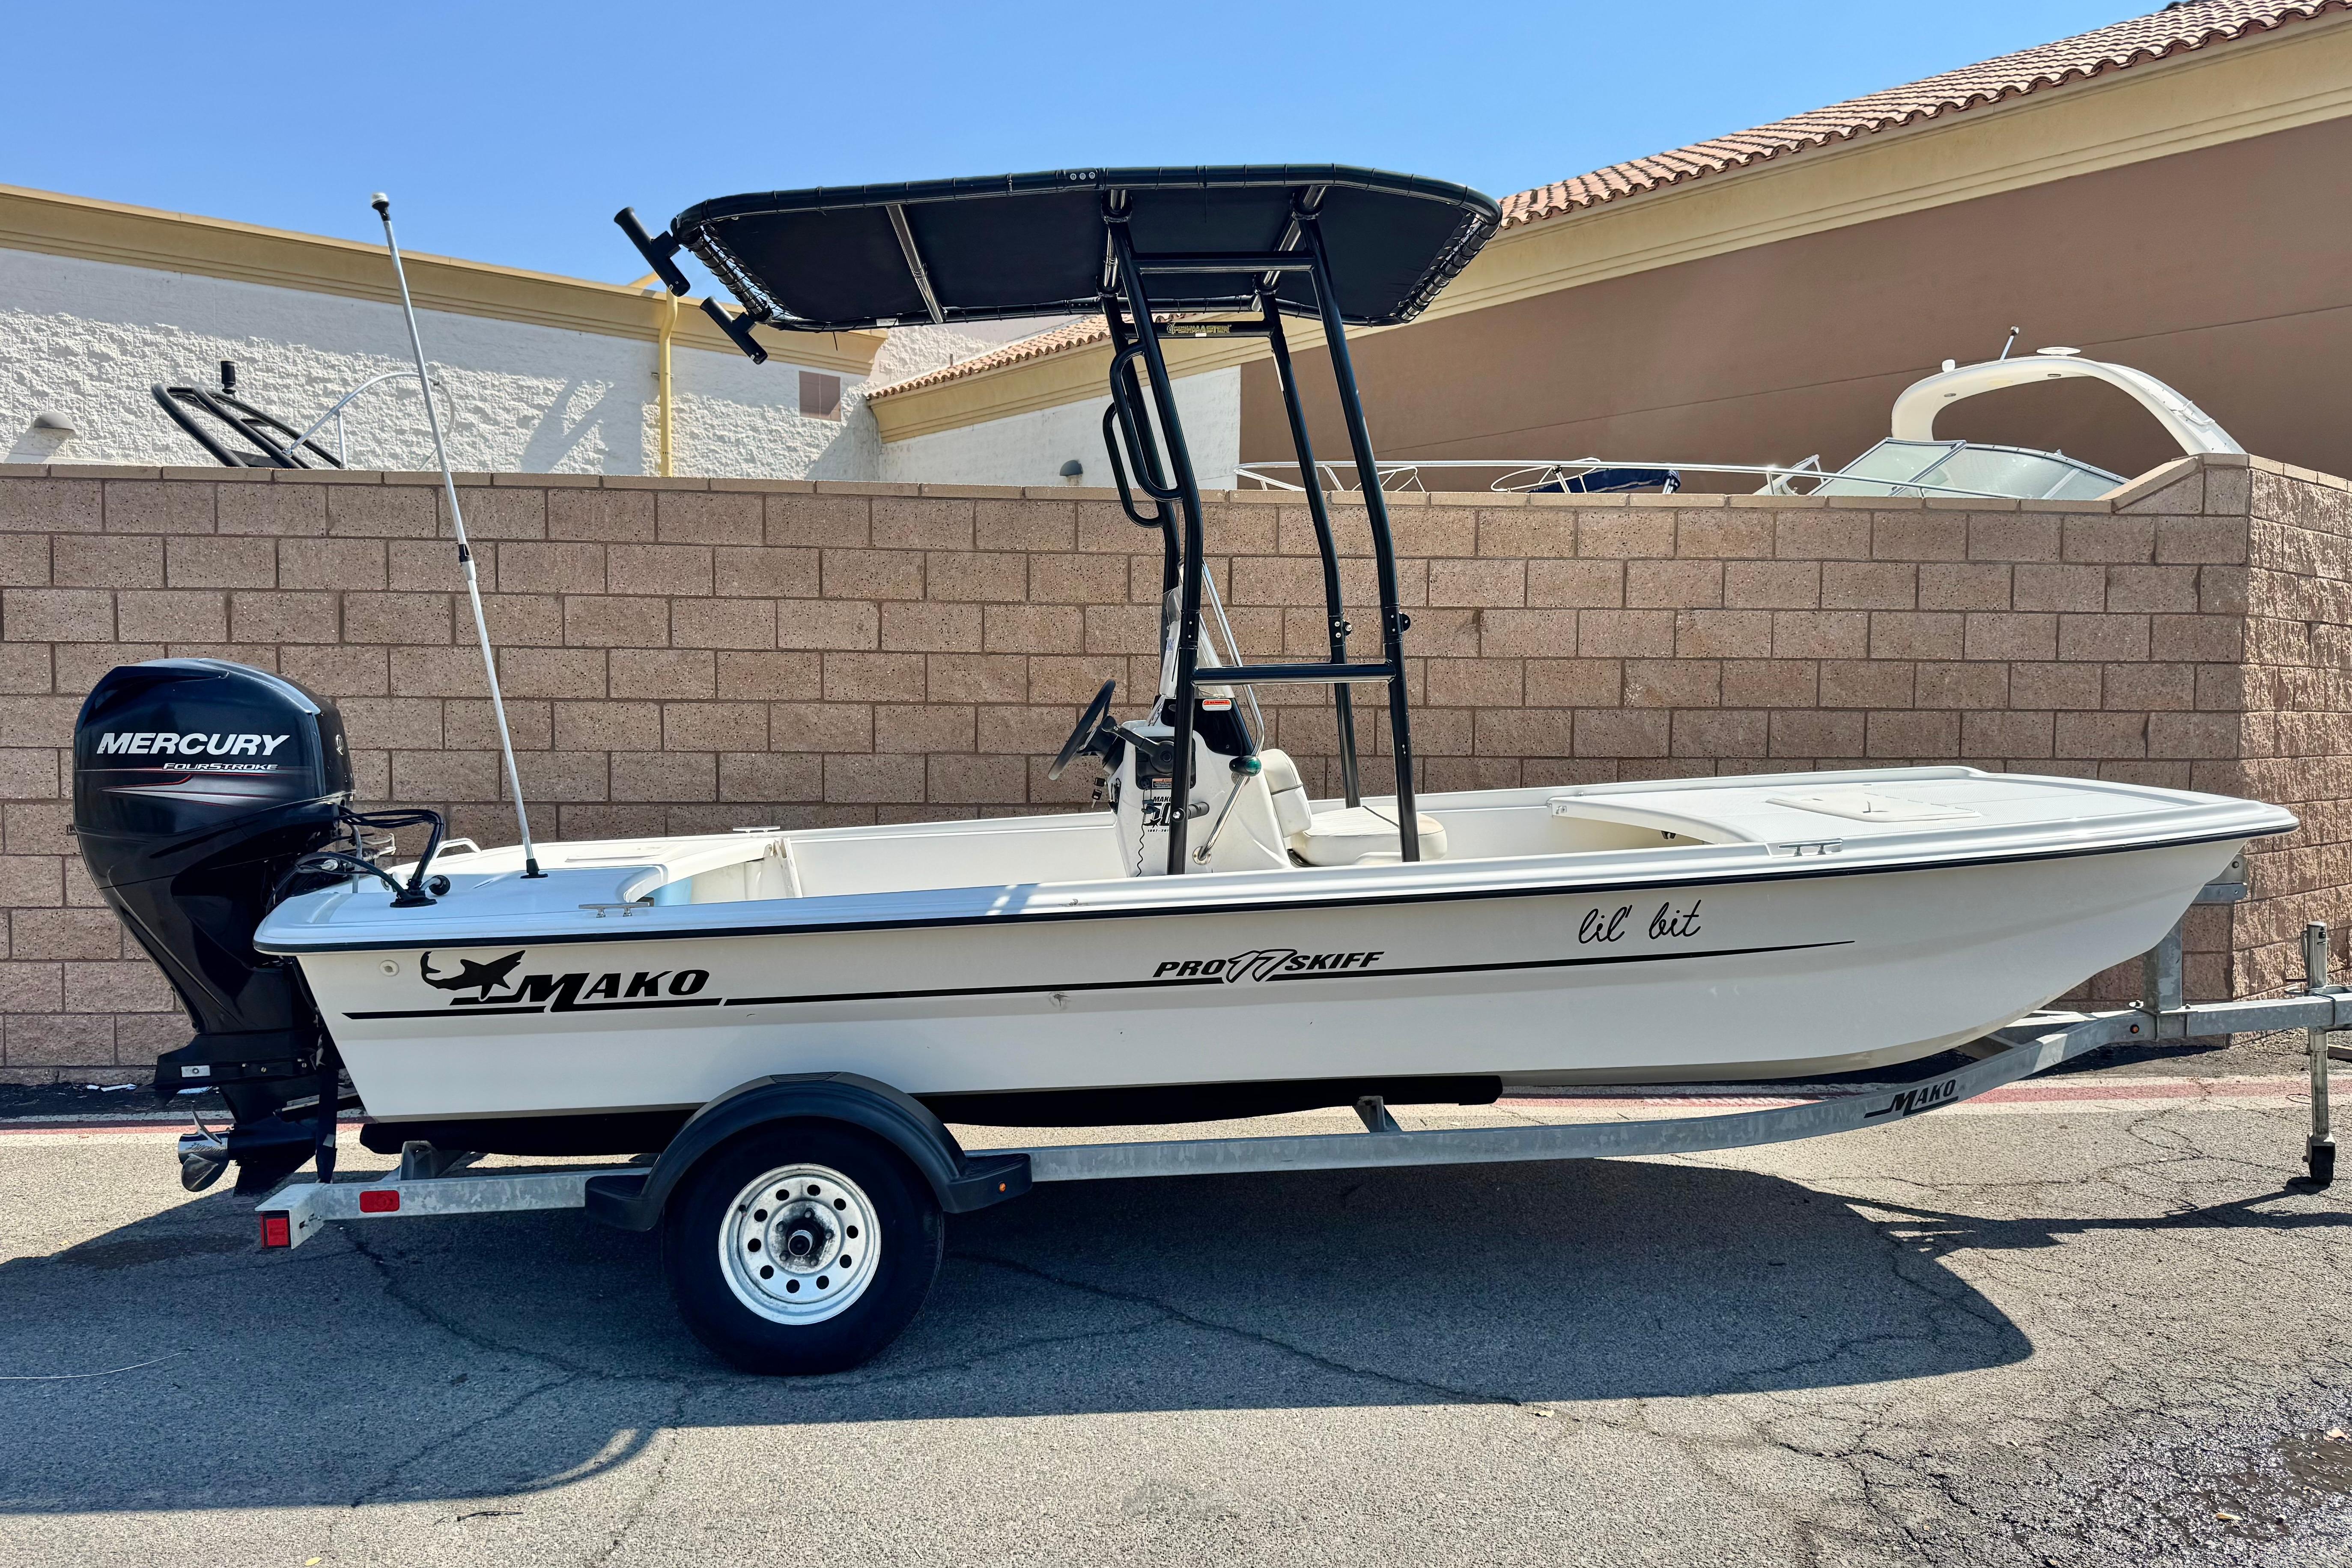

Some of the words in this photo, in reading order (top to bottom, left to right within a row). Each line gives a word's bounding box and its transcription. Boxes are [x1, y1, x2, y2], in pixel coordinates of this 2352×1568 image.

[96, 733, 290, 755] MERCURY
[1648, 899, 1702, 939] bit
[1152, 959, 1226, 978] PRO
[1226, 948, 1298, 984] 17
[1285, 951, 1385, 971] SKIFF
[507, 969, 711, 1013] MAKO
[1886, 1079, 1956, 1117] MAKO
